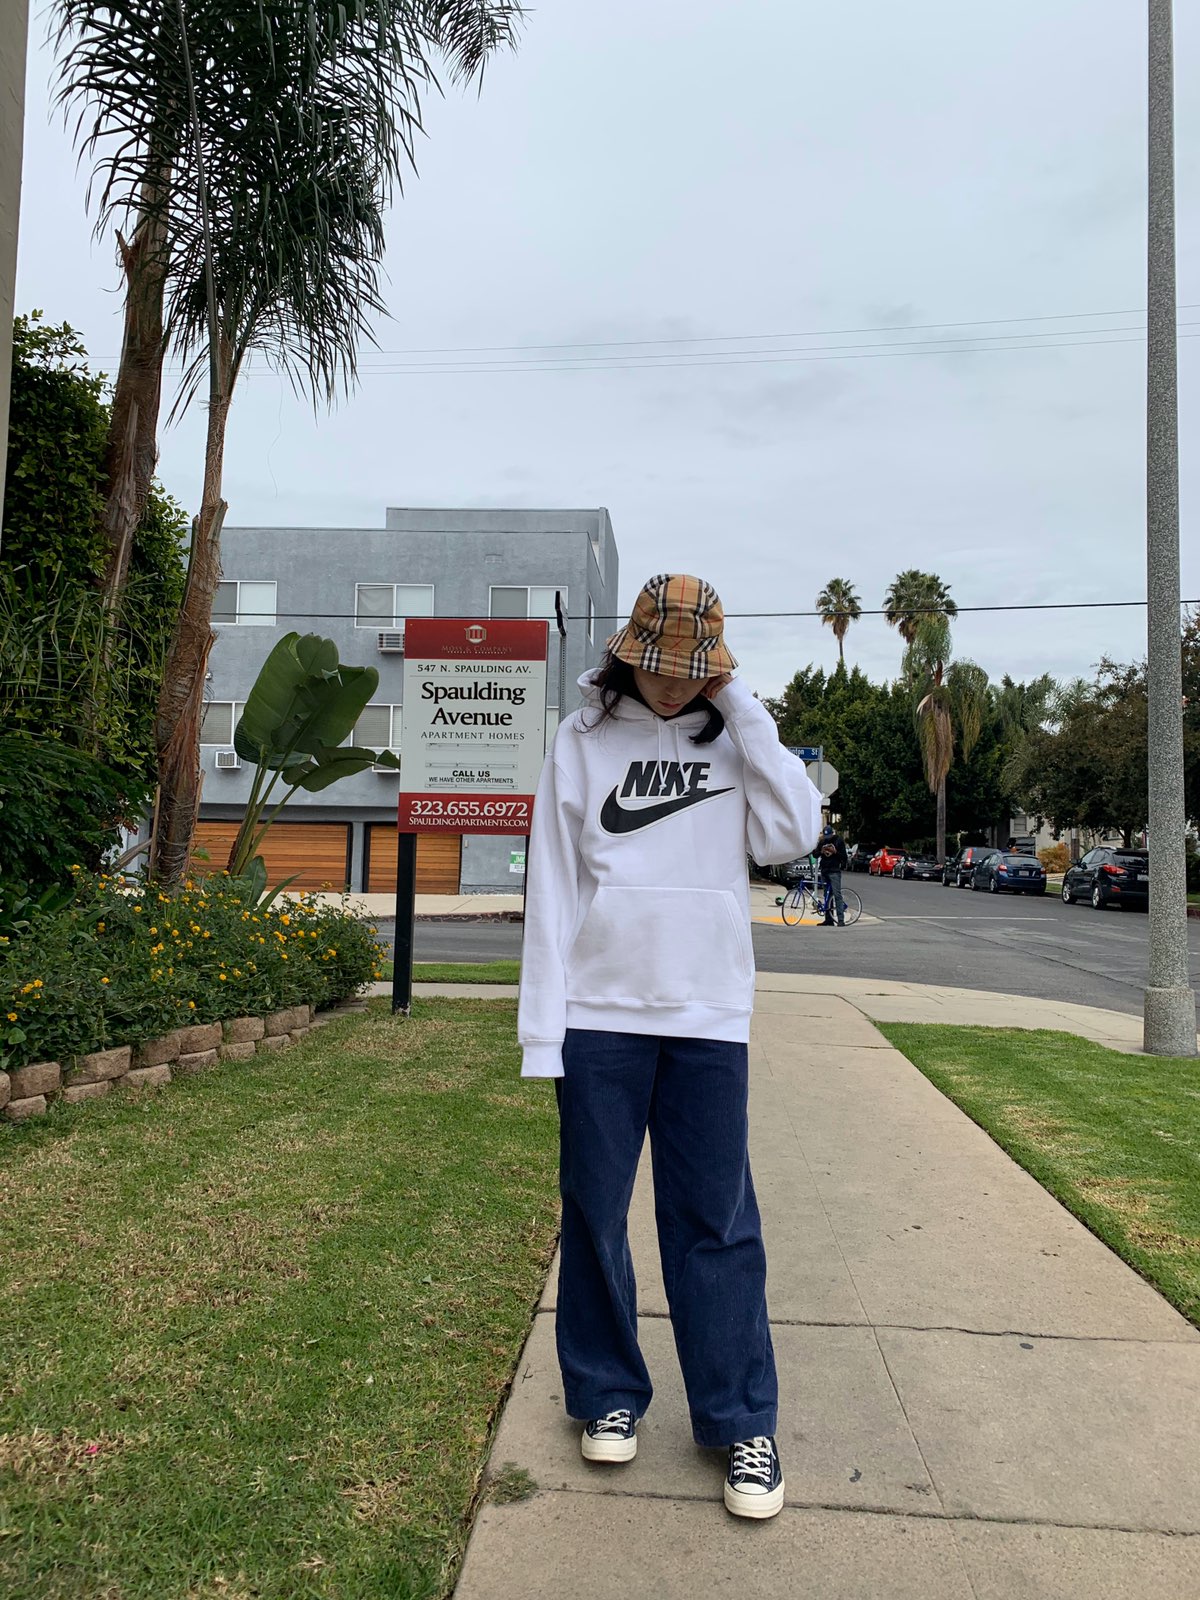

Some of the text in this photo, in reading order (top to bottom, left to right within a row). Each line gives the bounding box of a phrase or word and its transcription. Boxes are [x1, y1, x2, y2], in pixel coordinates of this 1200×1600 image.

[417, 664, 532, 674] 547 N. SPAULDING AV.
[421, 681, 527, 706] Spaulding
[430, 707, 513, 726] Avenue
[421, 731, 525, 740] APARTMENT HOMES
[811, 748, 818, 756] St
[452, 770, 491, 778] CALL US
[620, 760, 711, 798] NIKE
[410, 800, 528, 817] 323.655.6972
